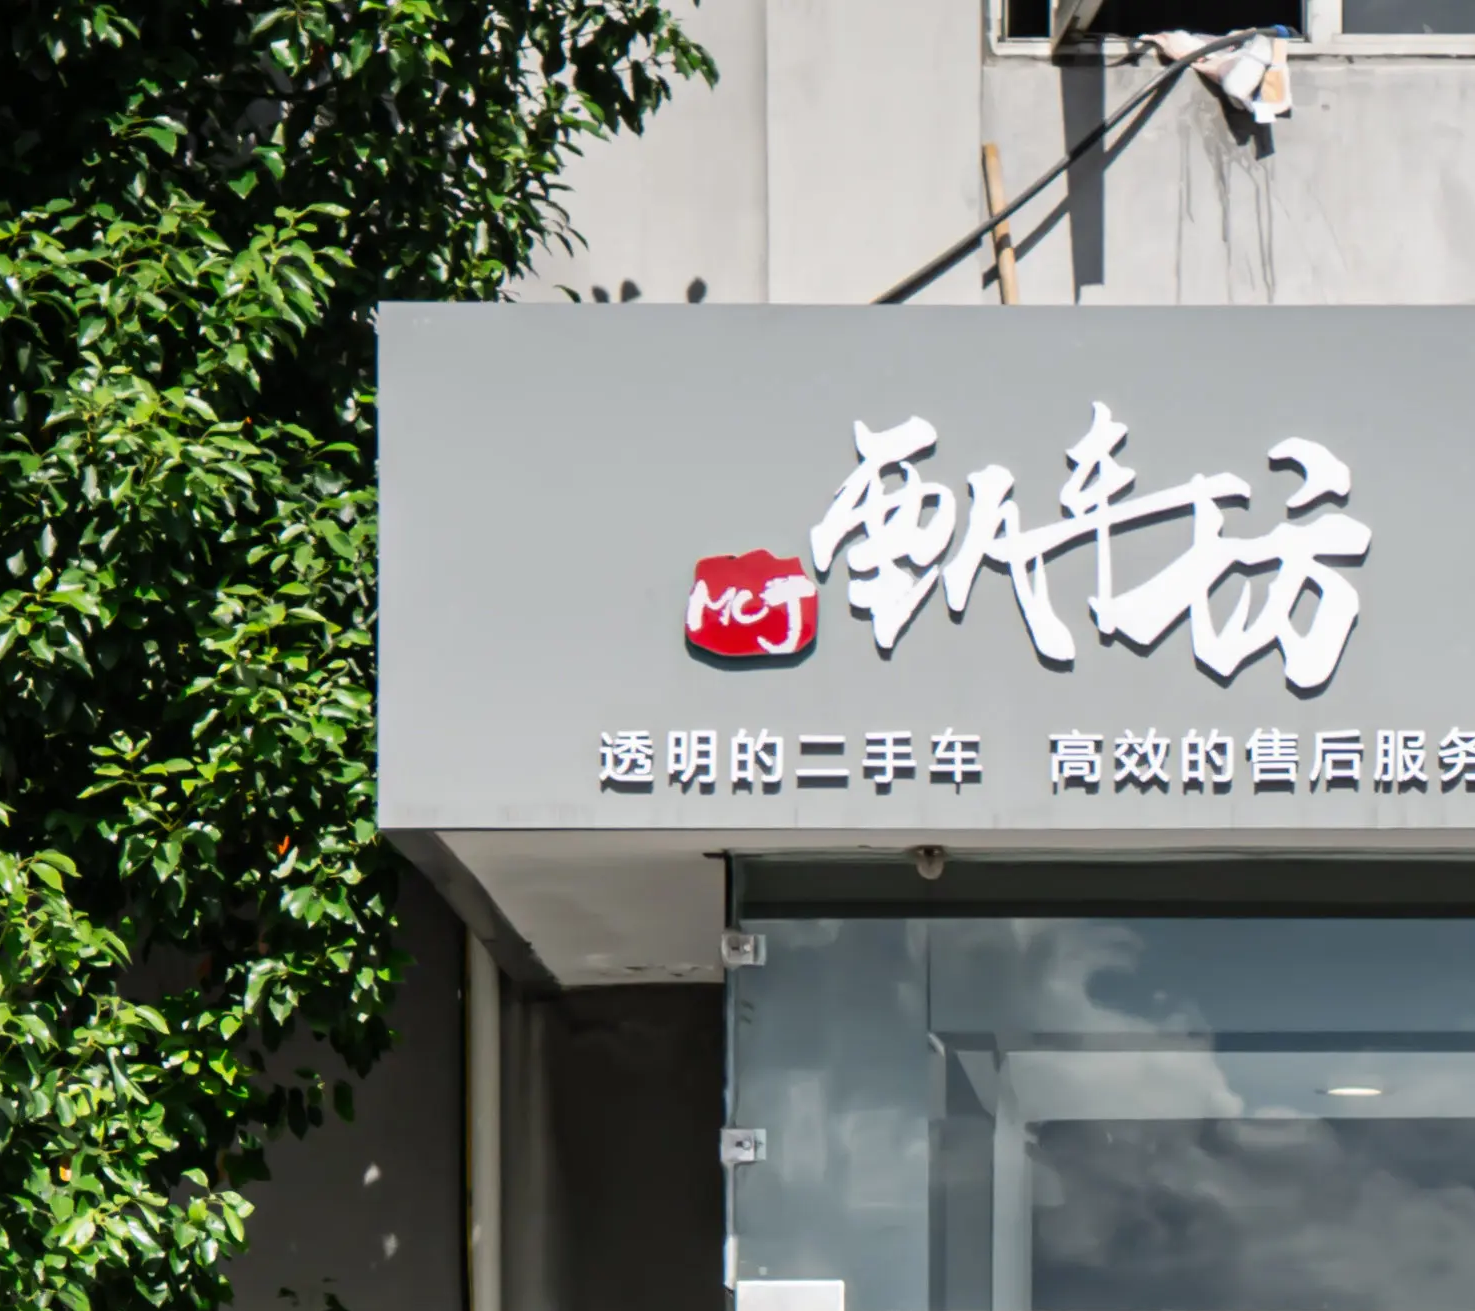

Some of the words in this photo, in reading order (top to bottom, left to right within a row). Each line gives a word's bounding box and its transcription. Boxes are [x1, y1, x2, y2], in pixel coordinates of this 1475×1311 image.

[598, 726, 985, 785] 透明的二手车
